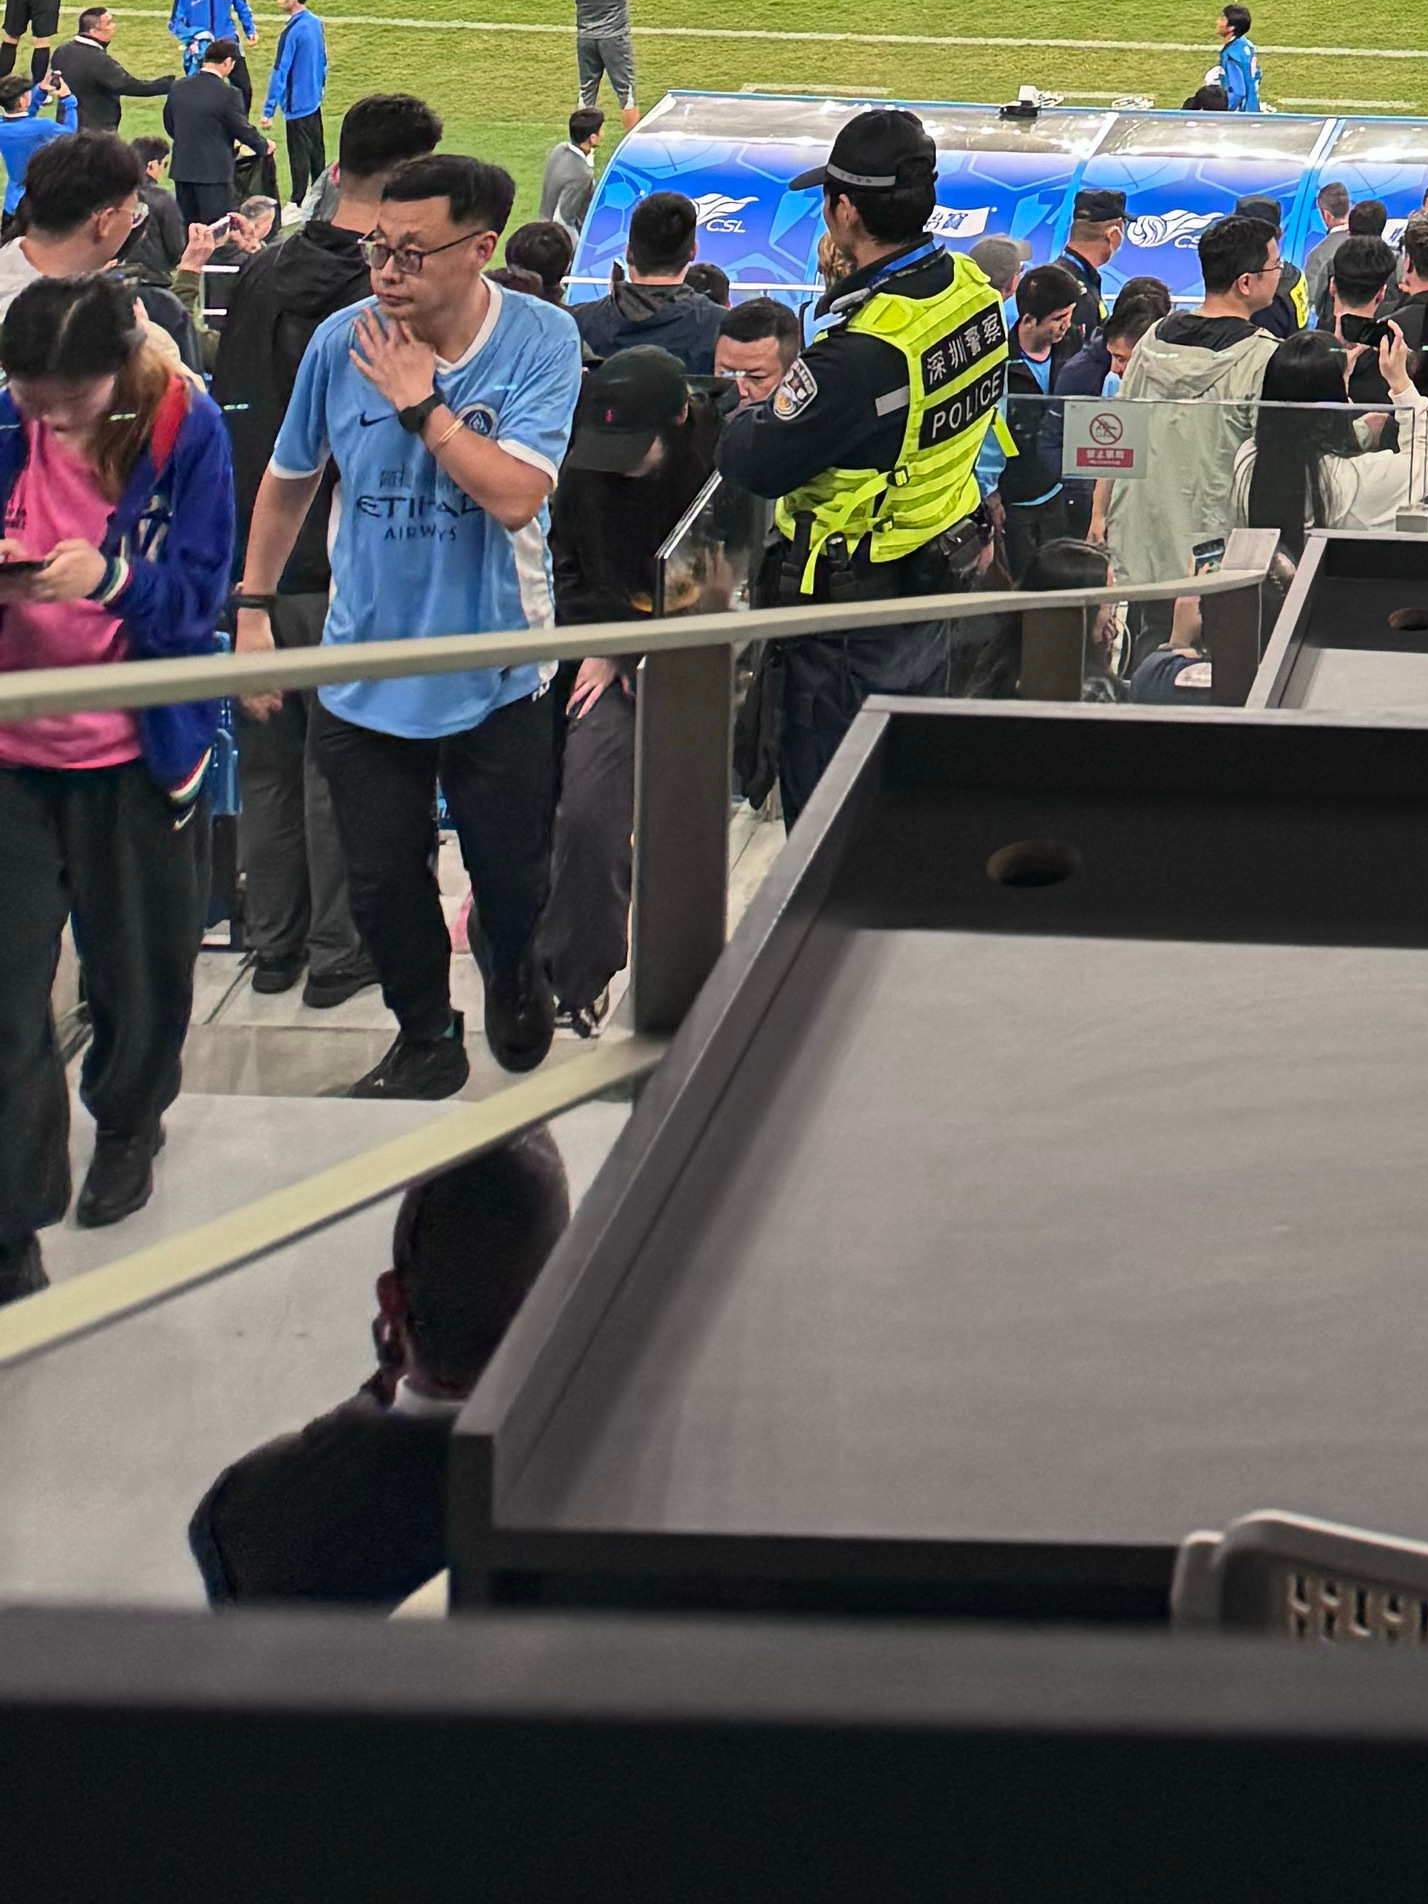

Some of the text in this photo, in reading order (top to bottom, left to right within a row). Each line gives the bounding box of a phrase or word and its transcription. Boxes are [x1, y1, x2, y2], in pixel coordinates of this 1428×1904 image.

[705, 218, 746, 234] CSL
[1174, 234, 1201, 250] CS
[926, 311, 1002, 386] 深圳警察
[931, 370, 1001, 440] POLICE
[384, 525, 456, 541] AIRWYS
